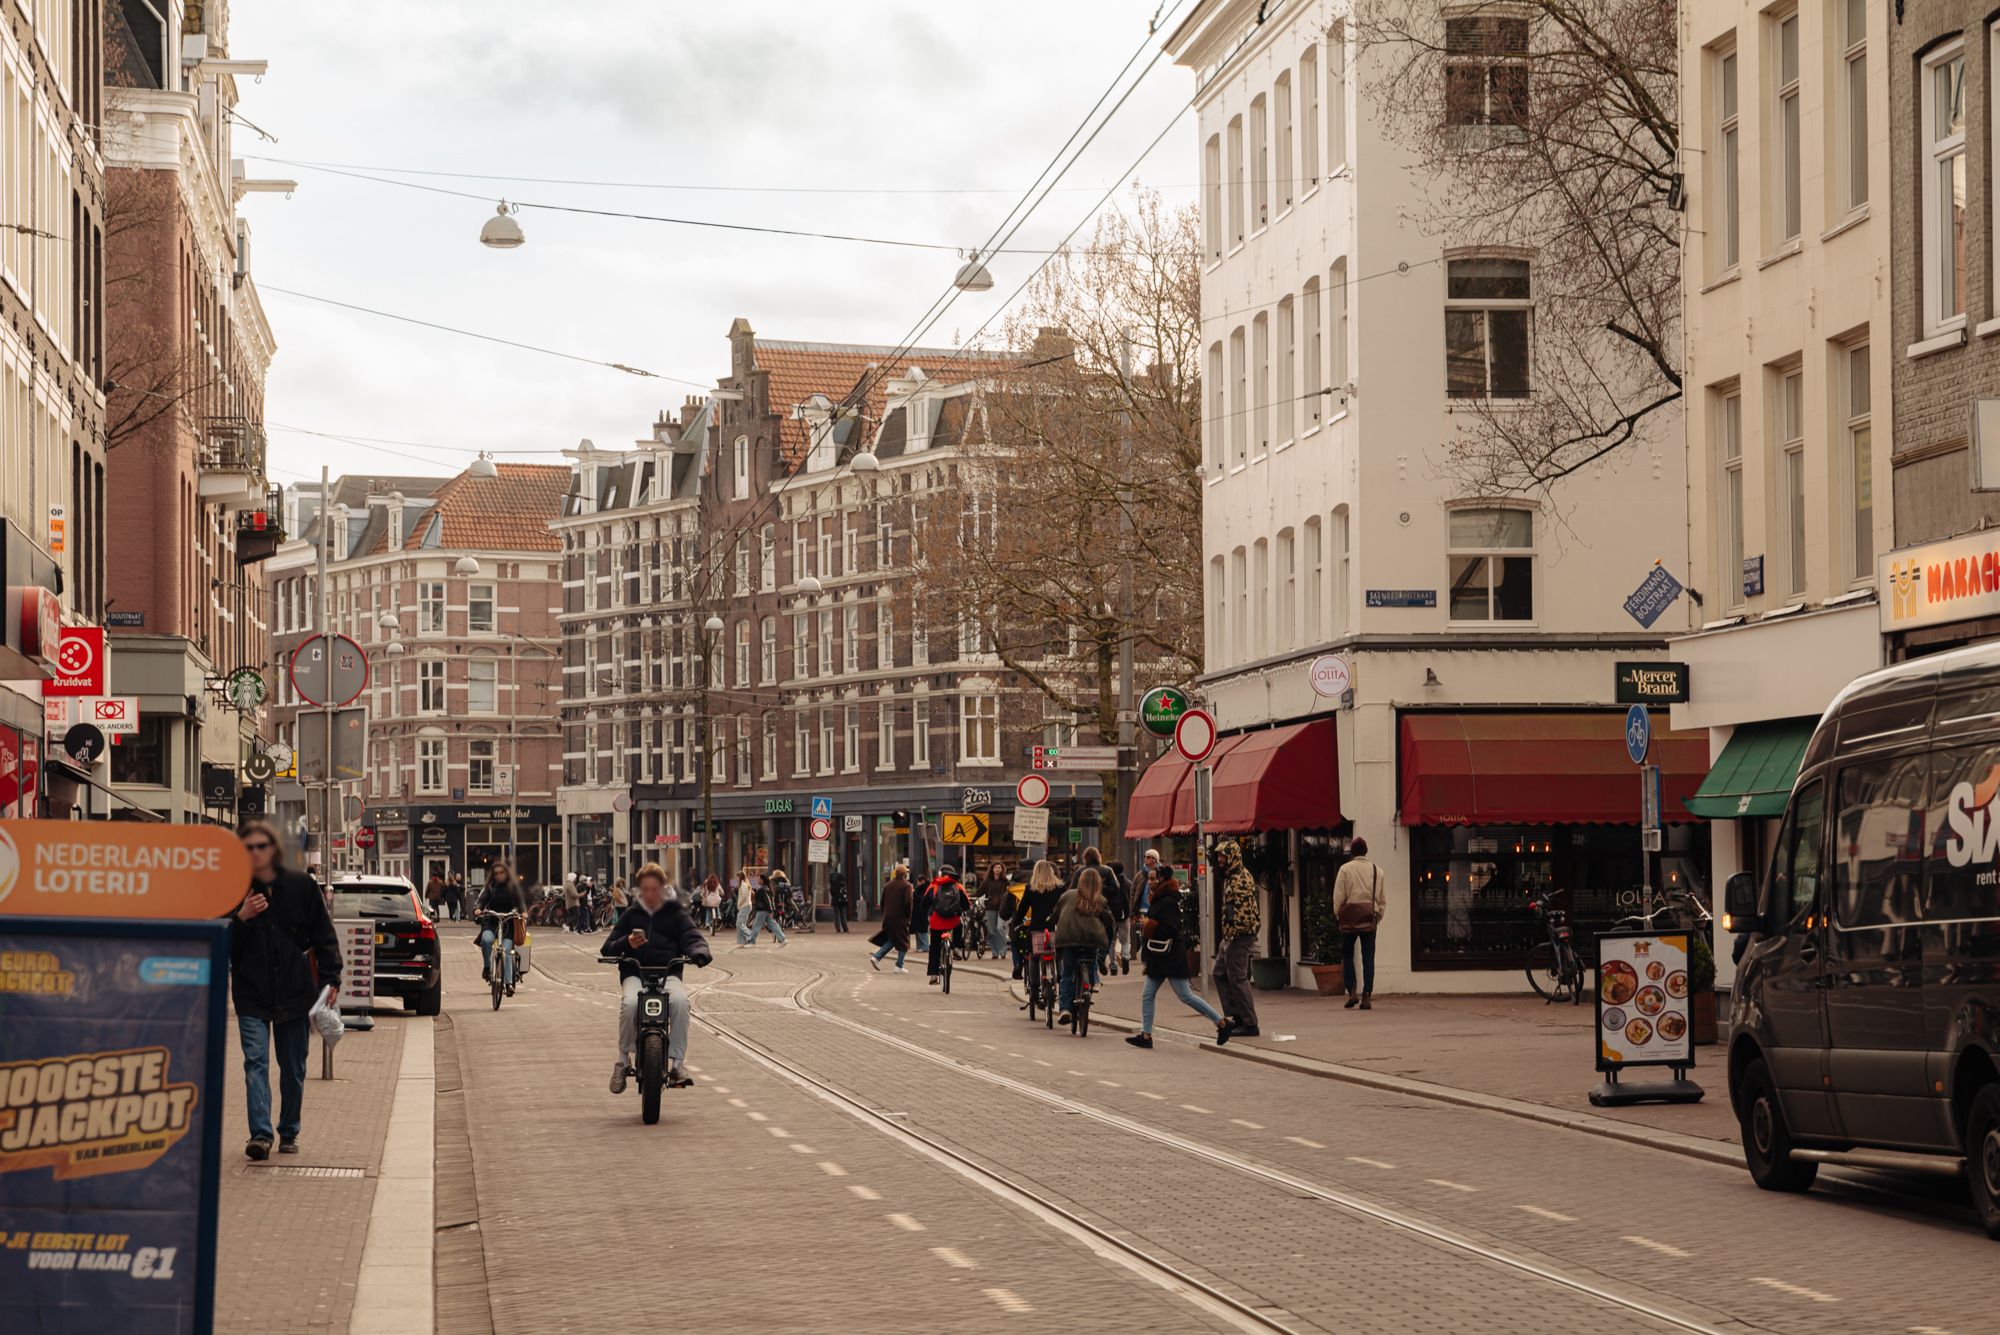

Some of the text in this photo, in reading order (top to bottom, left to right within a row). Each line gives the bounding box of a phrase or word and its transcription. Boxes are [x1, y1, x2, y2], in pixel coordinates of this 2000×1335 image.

[1626, 569, 1666, 613] FERDINAND
[1635, 578, 1673, 620] BOLSTRAAT
[53, 677, 93, 687] Kruidvat
[1314, 670, 1347, 681] LOLITA
[1631, 669, 1677, 682] Mercer
[1637, 681, 1680, 695] Brand.
[1146, 713, 1181, 722] Heineke
[963, 788, 991, 806] Etos
[765, 800, 792, 813] DOUGLAS
[846, 817, 860, 829] Etos
[951, 822, 967, 838] A
[35, 843, 221, 871] NEDERLANDSE
[34, 869, 150, 896] LOTERIJ
[1976, 868, 1997, 886] rent
[2, 953, 56, 971] EURO
[2, 1088, 192, 1150] JACKPOT
[76, 1138, 166, 1160] VAN NEDERLAND
[7, 1232, 31, 1249] JE
[32, 1232, 96, 1250] EERSTE
[96, 1234, 129, 1251] LOT
[28, 1246, 178, 1279] VOOR MAAR €1
